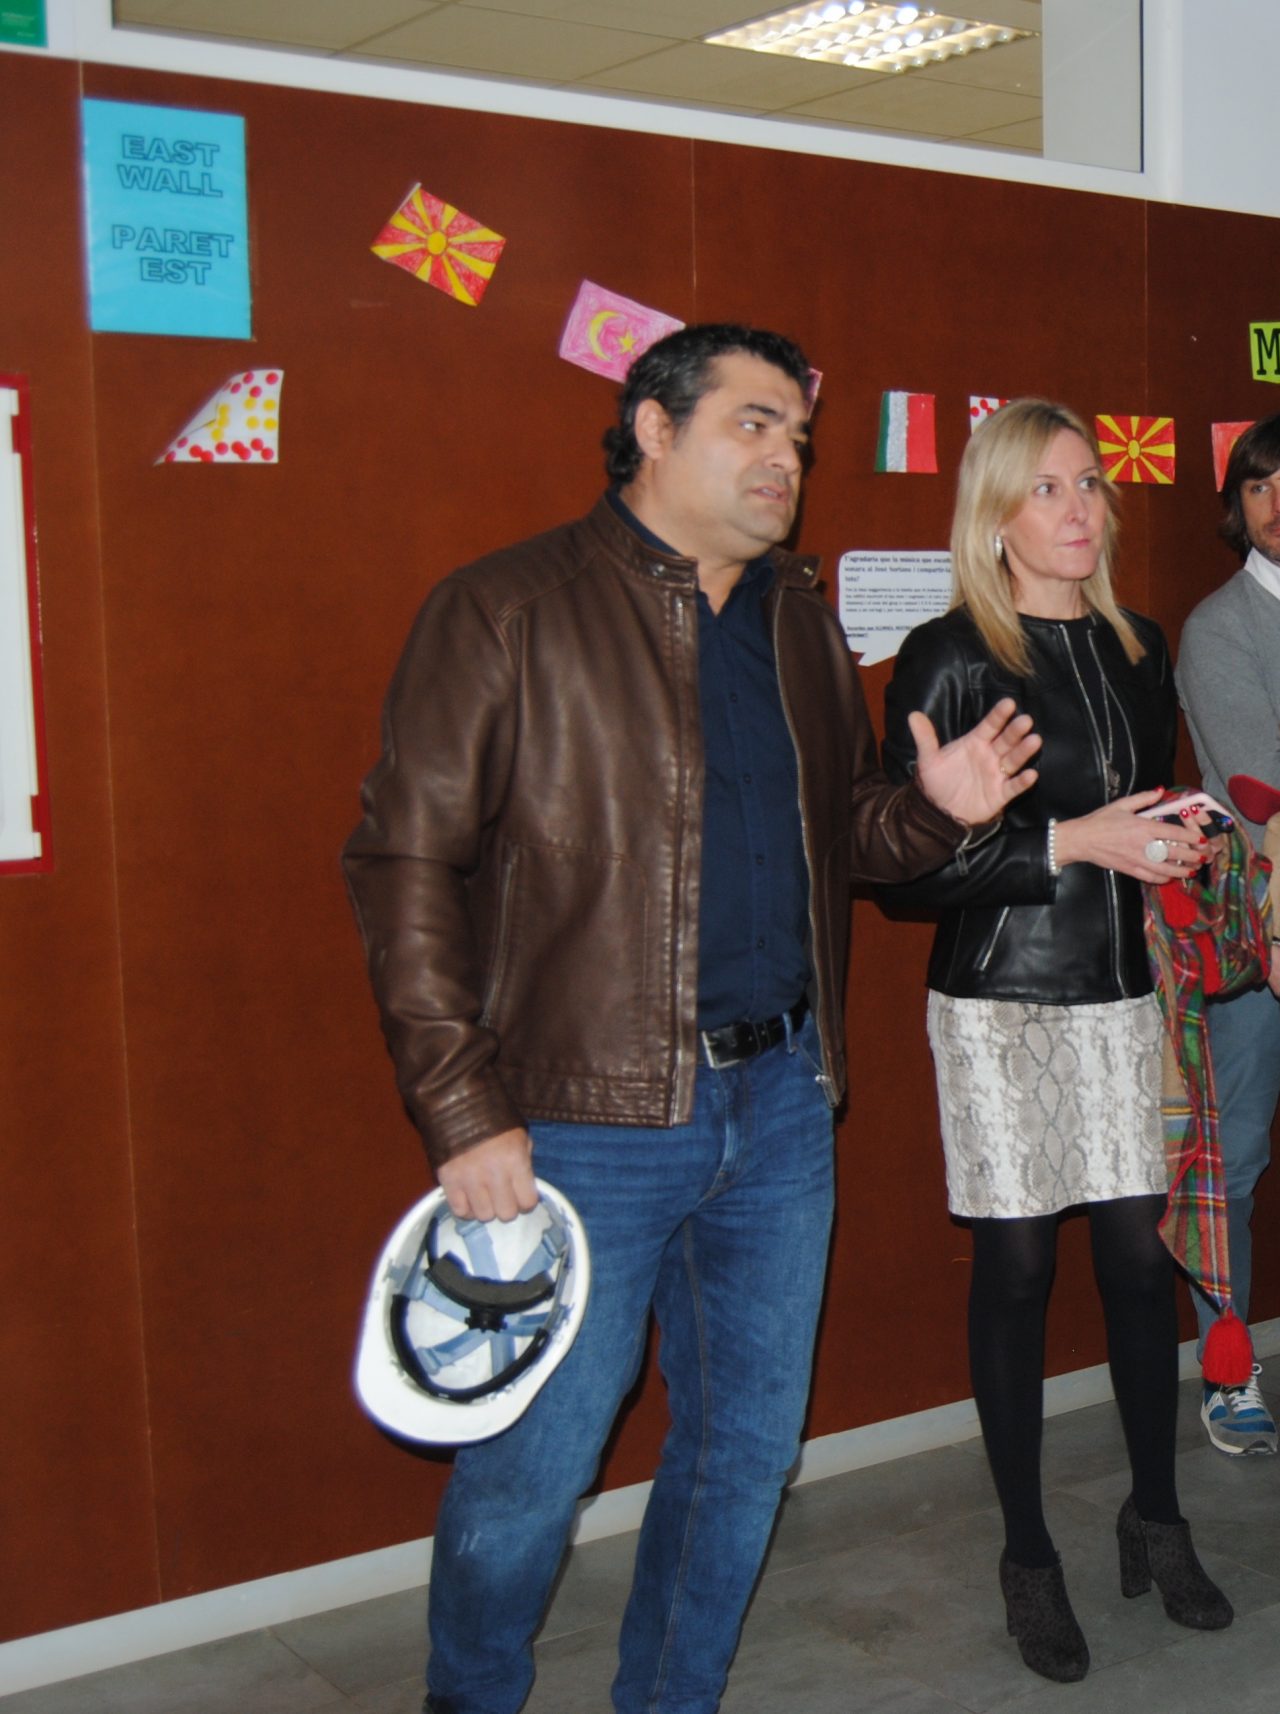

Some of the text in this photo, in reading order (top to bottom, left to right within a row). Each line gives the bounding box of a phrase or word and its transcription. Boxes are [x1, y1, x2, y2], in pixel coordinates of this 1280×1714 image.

[121, 133, 221, 168] EAST
[116, 163, 224, 198] WALL
[111, 223, 235, 258] PARET
[139, 256, 212, 286] EST
